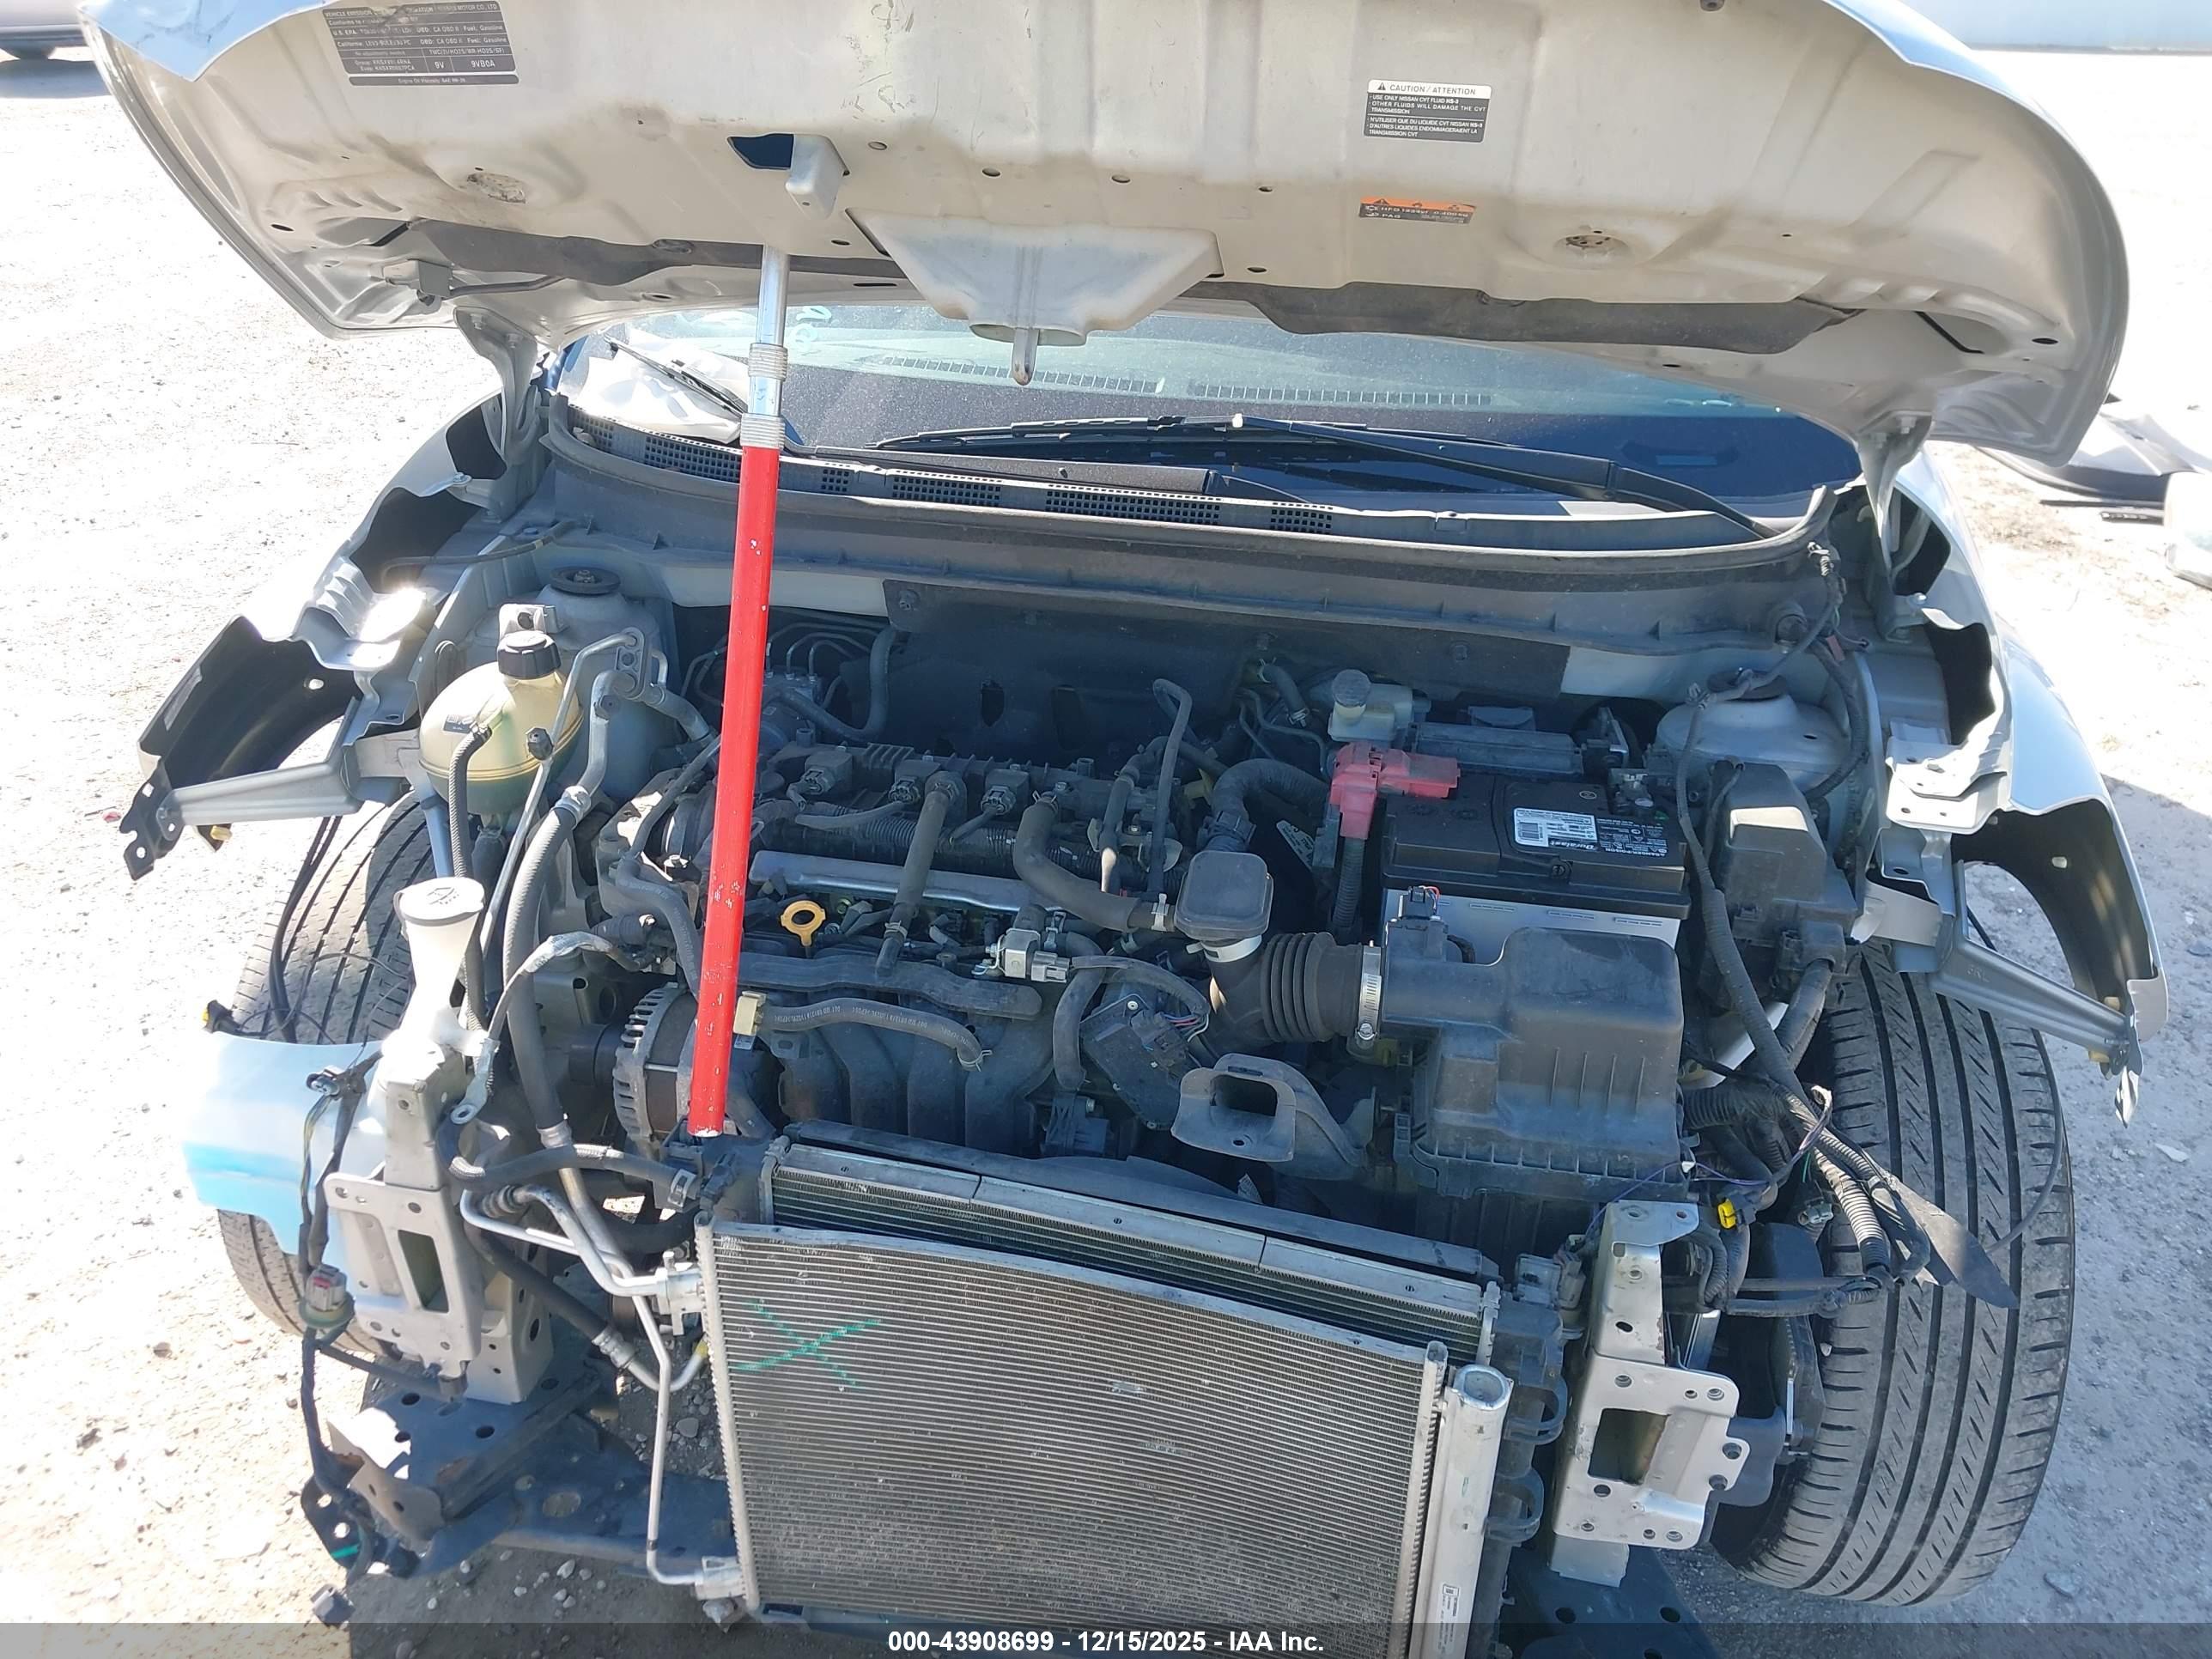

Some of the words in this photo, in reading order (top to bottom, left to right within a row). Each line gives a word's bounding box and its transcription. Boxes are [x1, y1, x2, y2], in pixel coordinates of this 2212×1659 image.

[1389, 84, 1425, 93] CAUTION
[1432, 87, 1476, 96] ATTENTION
[1549, 840, 1595, 851] Duralast
